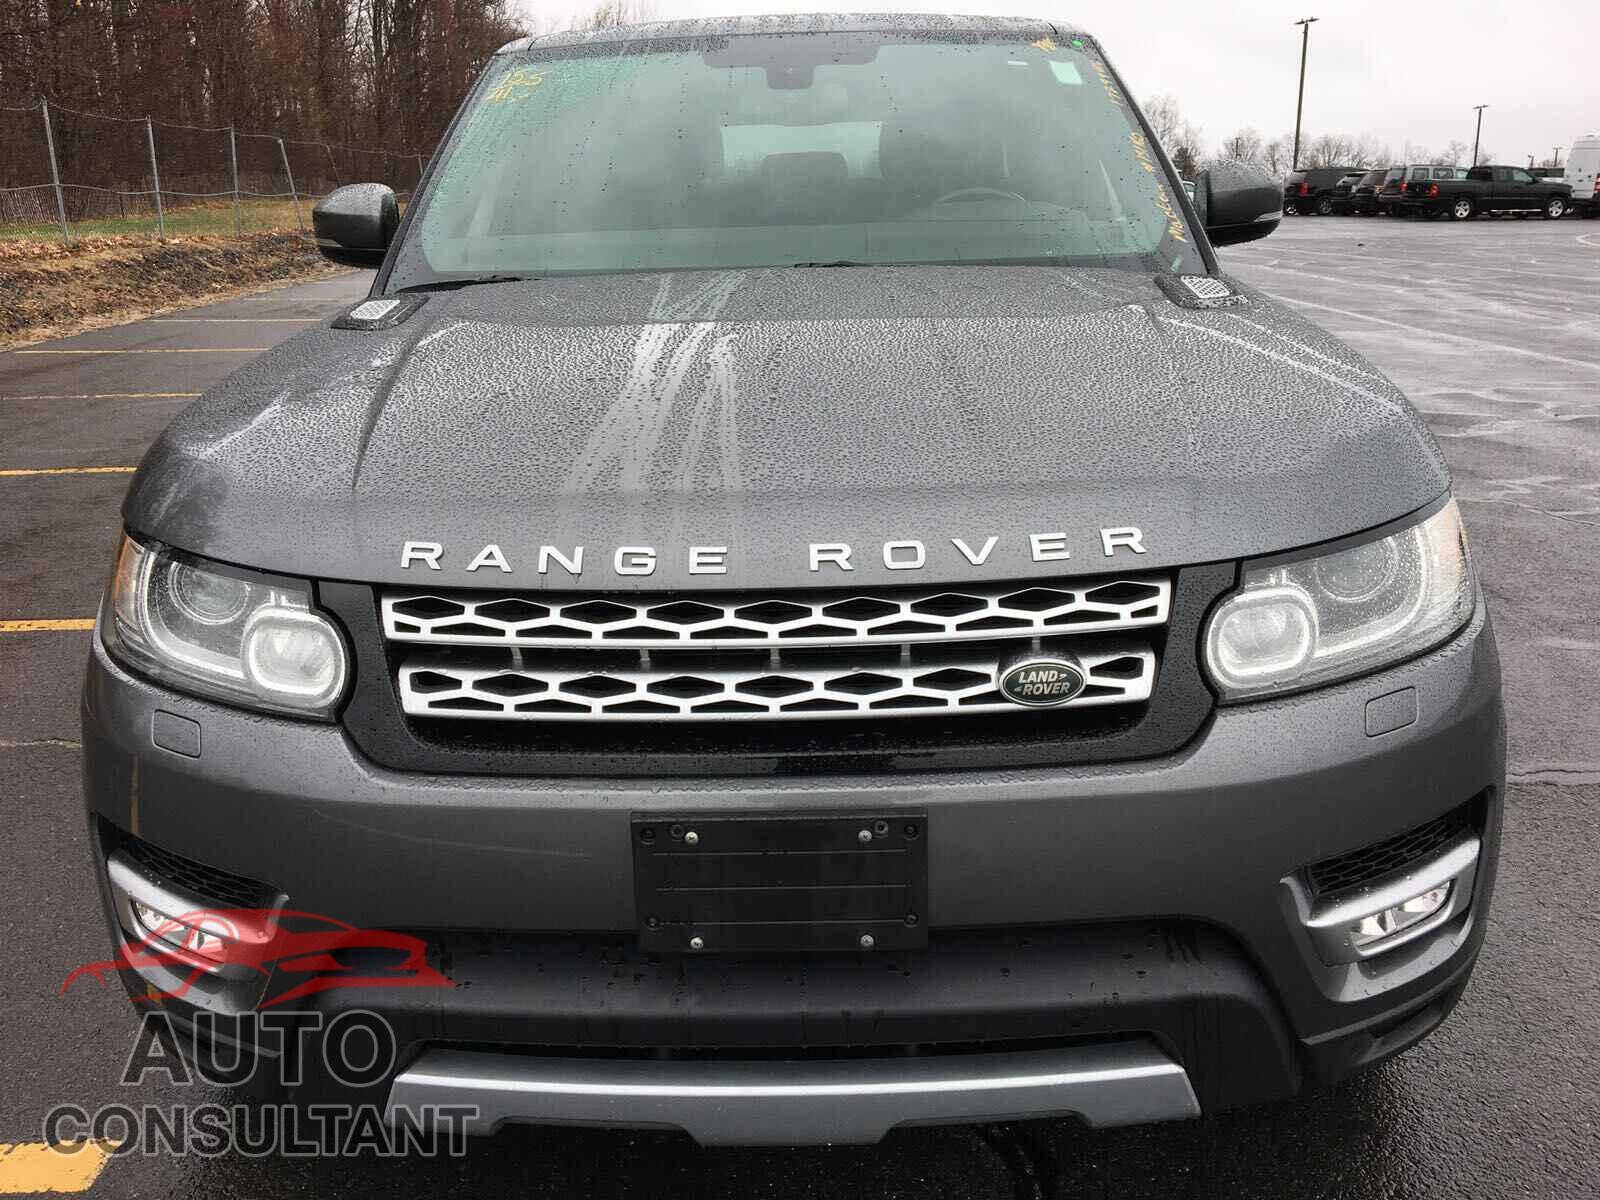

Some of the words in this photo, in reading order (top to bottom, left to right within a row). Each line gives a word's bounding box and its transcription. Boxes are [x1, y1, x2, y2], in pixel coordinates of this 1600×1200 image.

[400, 540, 728, 576] RANGE
[808, 526, 1147, 572] ROVER
[1018, 670, 1058, 683] LAND
[1022, 682, 1071, 695] ROVER
